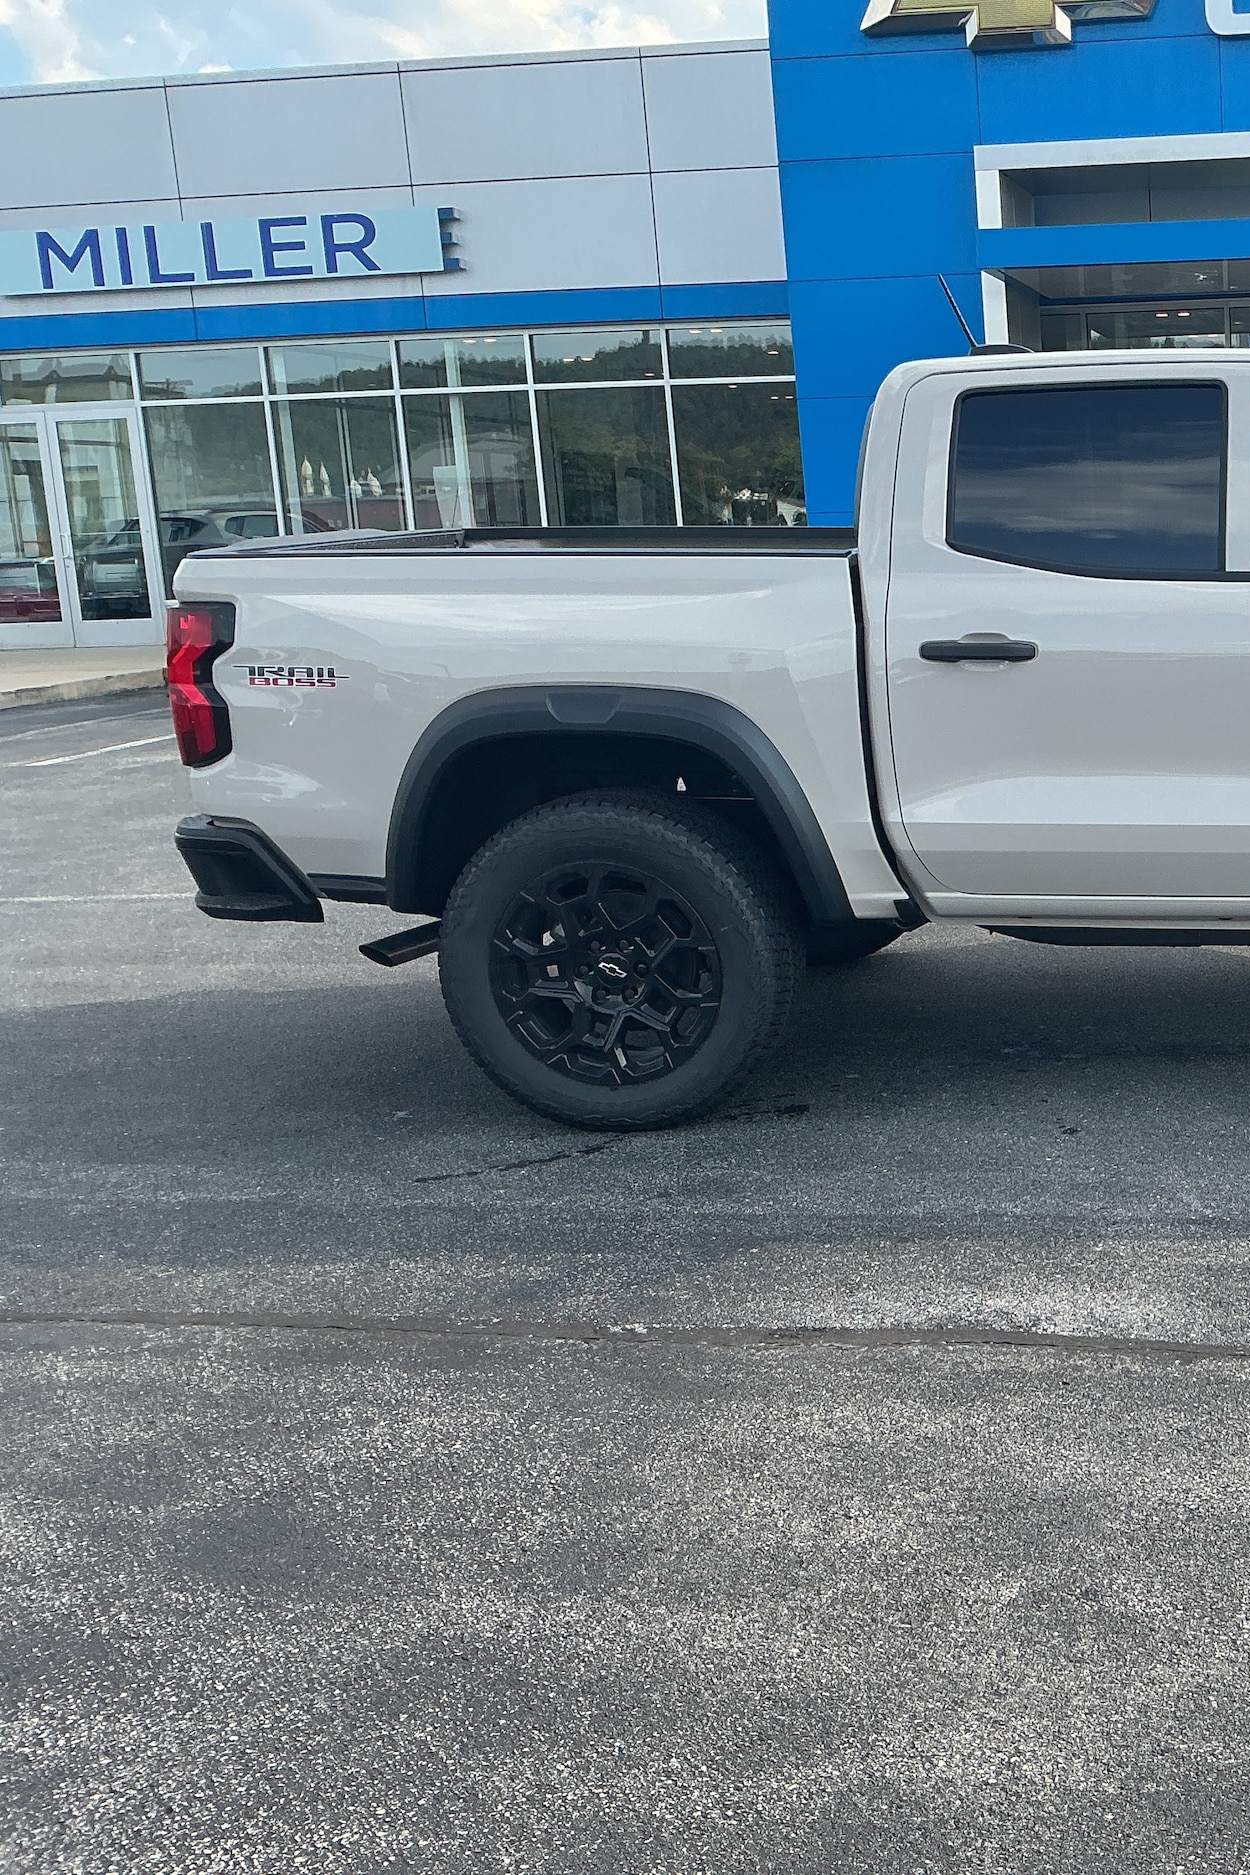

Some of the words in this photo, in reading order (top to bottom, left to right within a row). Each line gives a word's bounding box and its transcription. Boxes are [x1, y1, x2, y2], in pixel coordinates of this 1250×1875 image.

[36, 213, 382, 290] MILLER
[232, 665, 350, 678] TRAIL
[249, 677, 336, 688] BOSS
